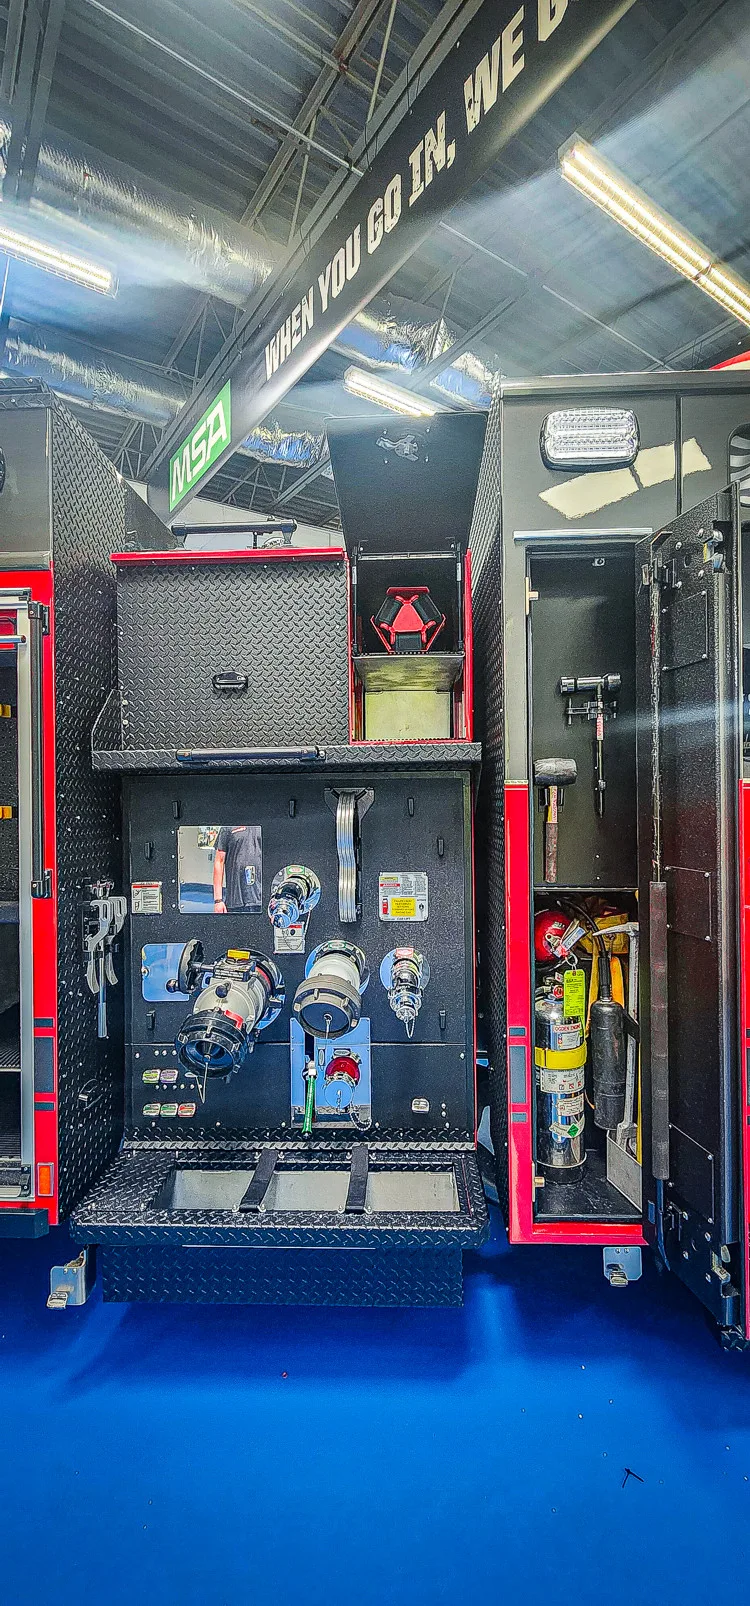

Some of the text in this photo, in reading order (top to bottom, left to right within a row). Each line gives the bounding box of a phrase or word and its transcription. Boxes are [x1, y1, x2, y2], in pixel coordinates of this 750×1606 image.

[264, 287, 315, 380] WHEN
[317, 224, 361, 313] YOU
[367, 174, 402, 255] GO
[408, 110, 457, 207] IN,
[463, 5, 525, 135] WE
[171, 400, 228, 502] MSA
